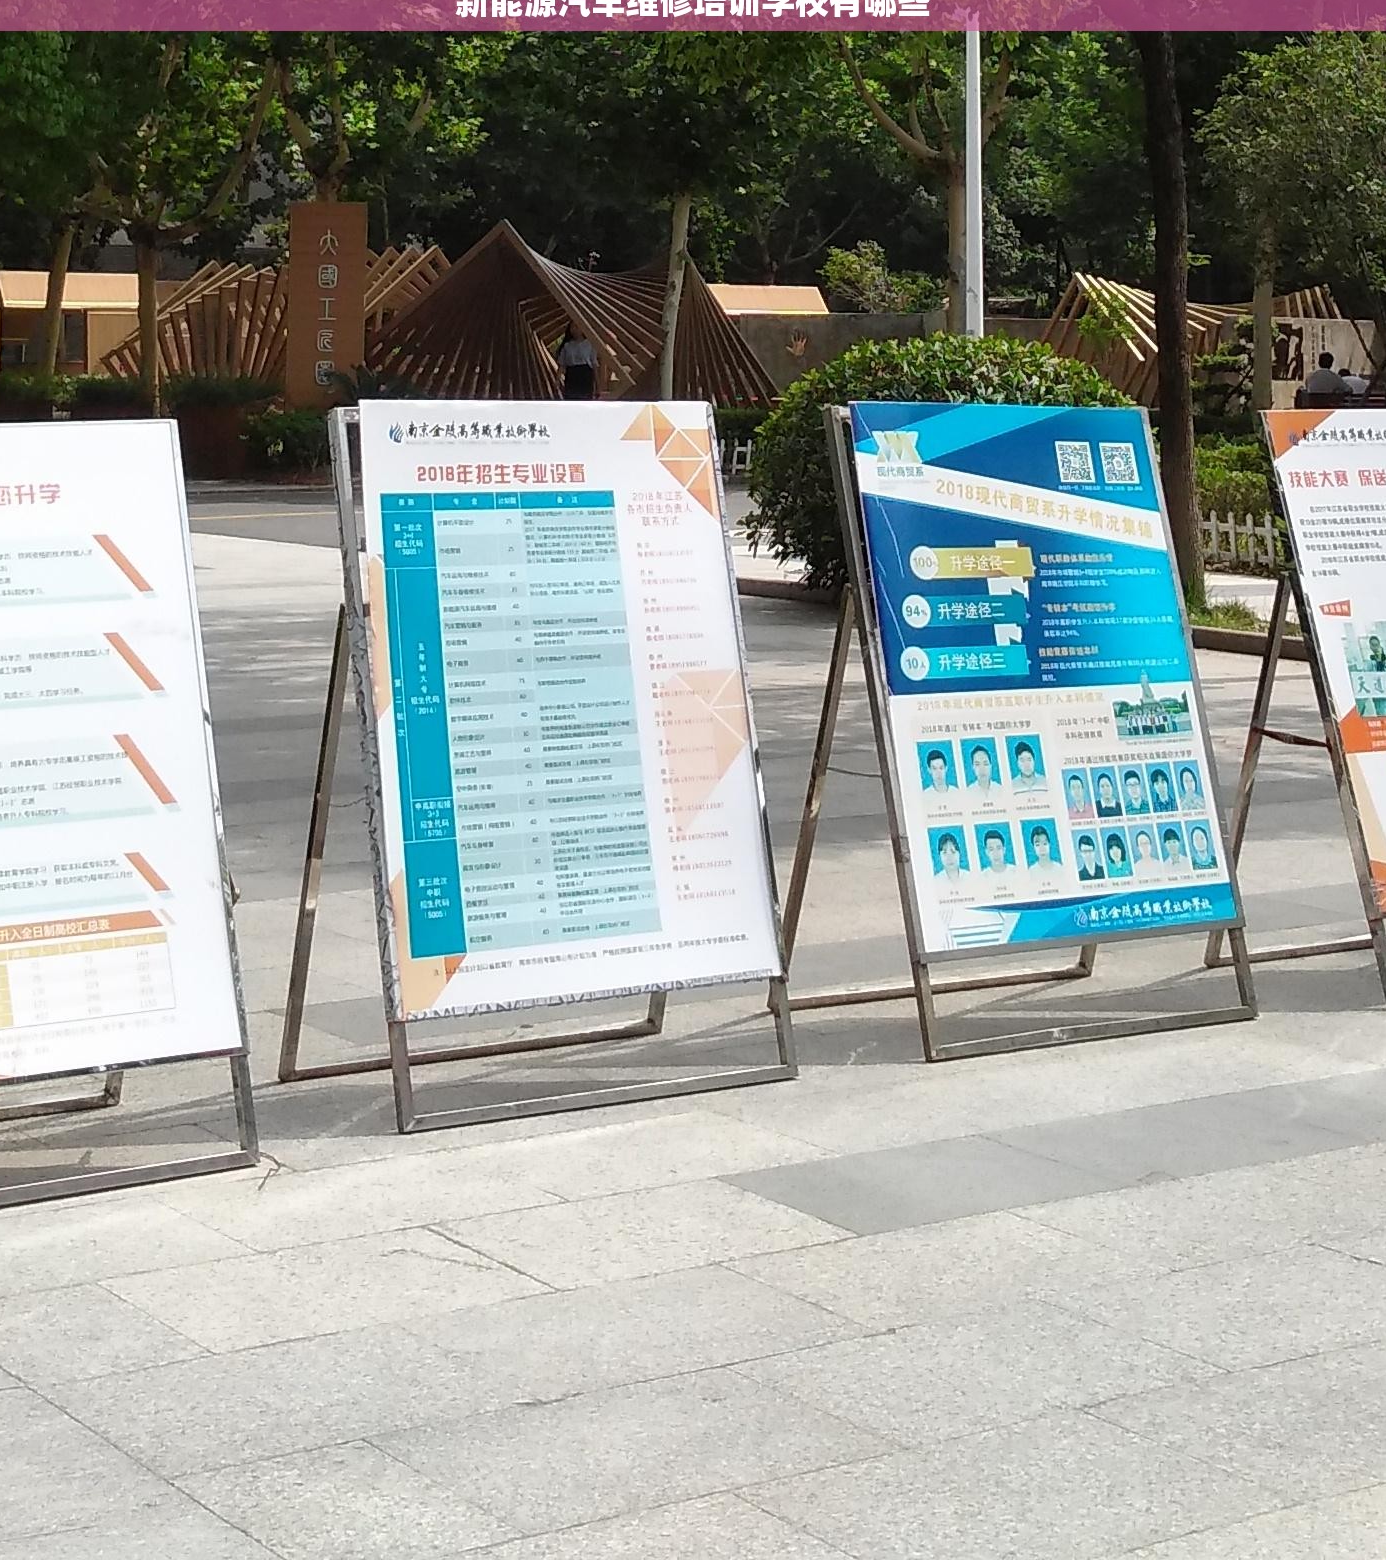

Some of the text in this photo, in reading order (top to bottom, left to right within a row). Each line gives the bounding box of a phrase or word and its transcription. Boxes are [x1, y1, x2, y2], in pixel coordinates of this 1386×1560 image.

[416, 462, 587, 484] 2018年招生专业设置
[876, 466, 924, 477] 现代商贸系
[1288, 470, 1350, 489] 技能大赛
[948, 554, 1016, 572] 升学途径一
[937, 601, 1006, 619] 升学途径二
[938, 652, 1007, 671] 升学途径三
